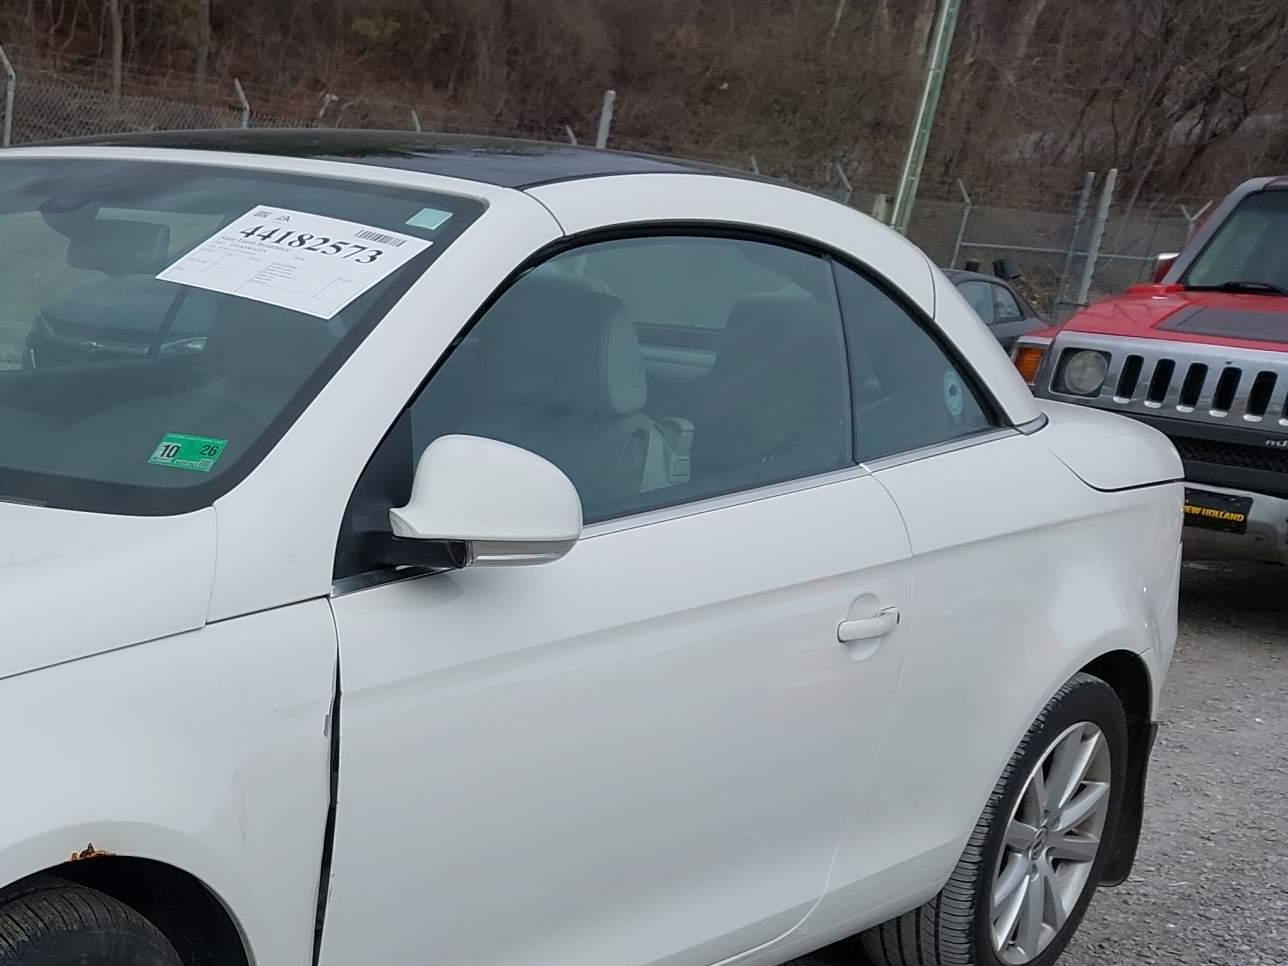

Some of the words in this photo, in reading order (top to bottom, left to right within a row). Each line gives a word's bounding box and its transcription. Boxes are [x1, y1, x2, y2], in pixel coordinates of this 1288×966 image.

[240, 225, 383, 263] 44182573
[160, 445, 181, 458] 10
[200, 444, 219, 456] 26
[1202, 508, 1245, 522] HOLLAND
